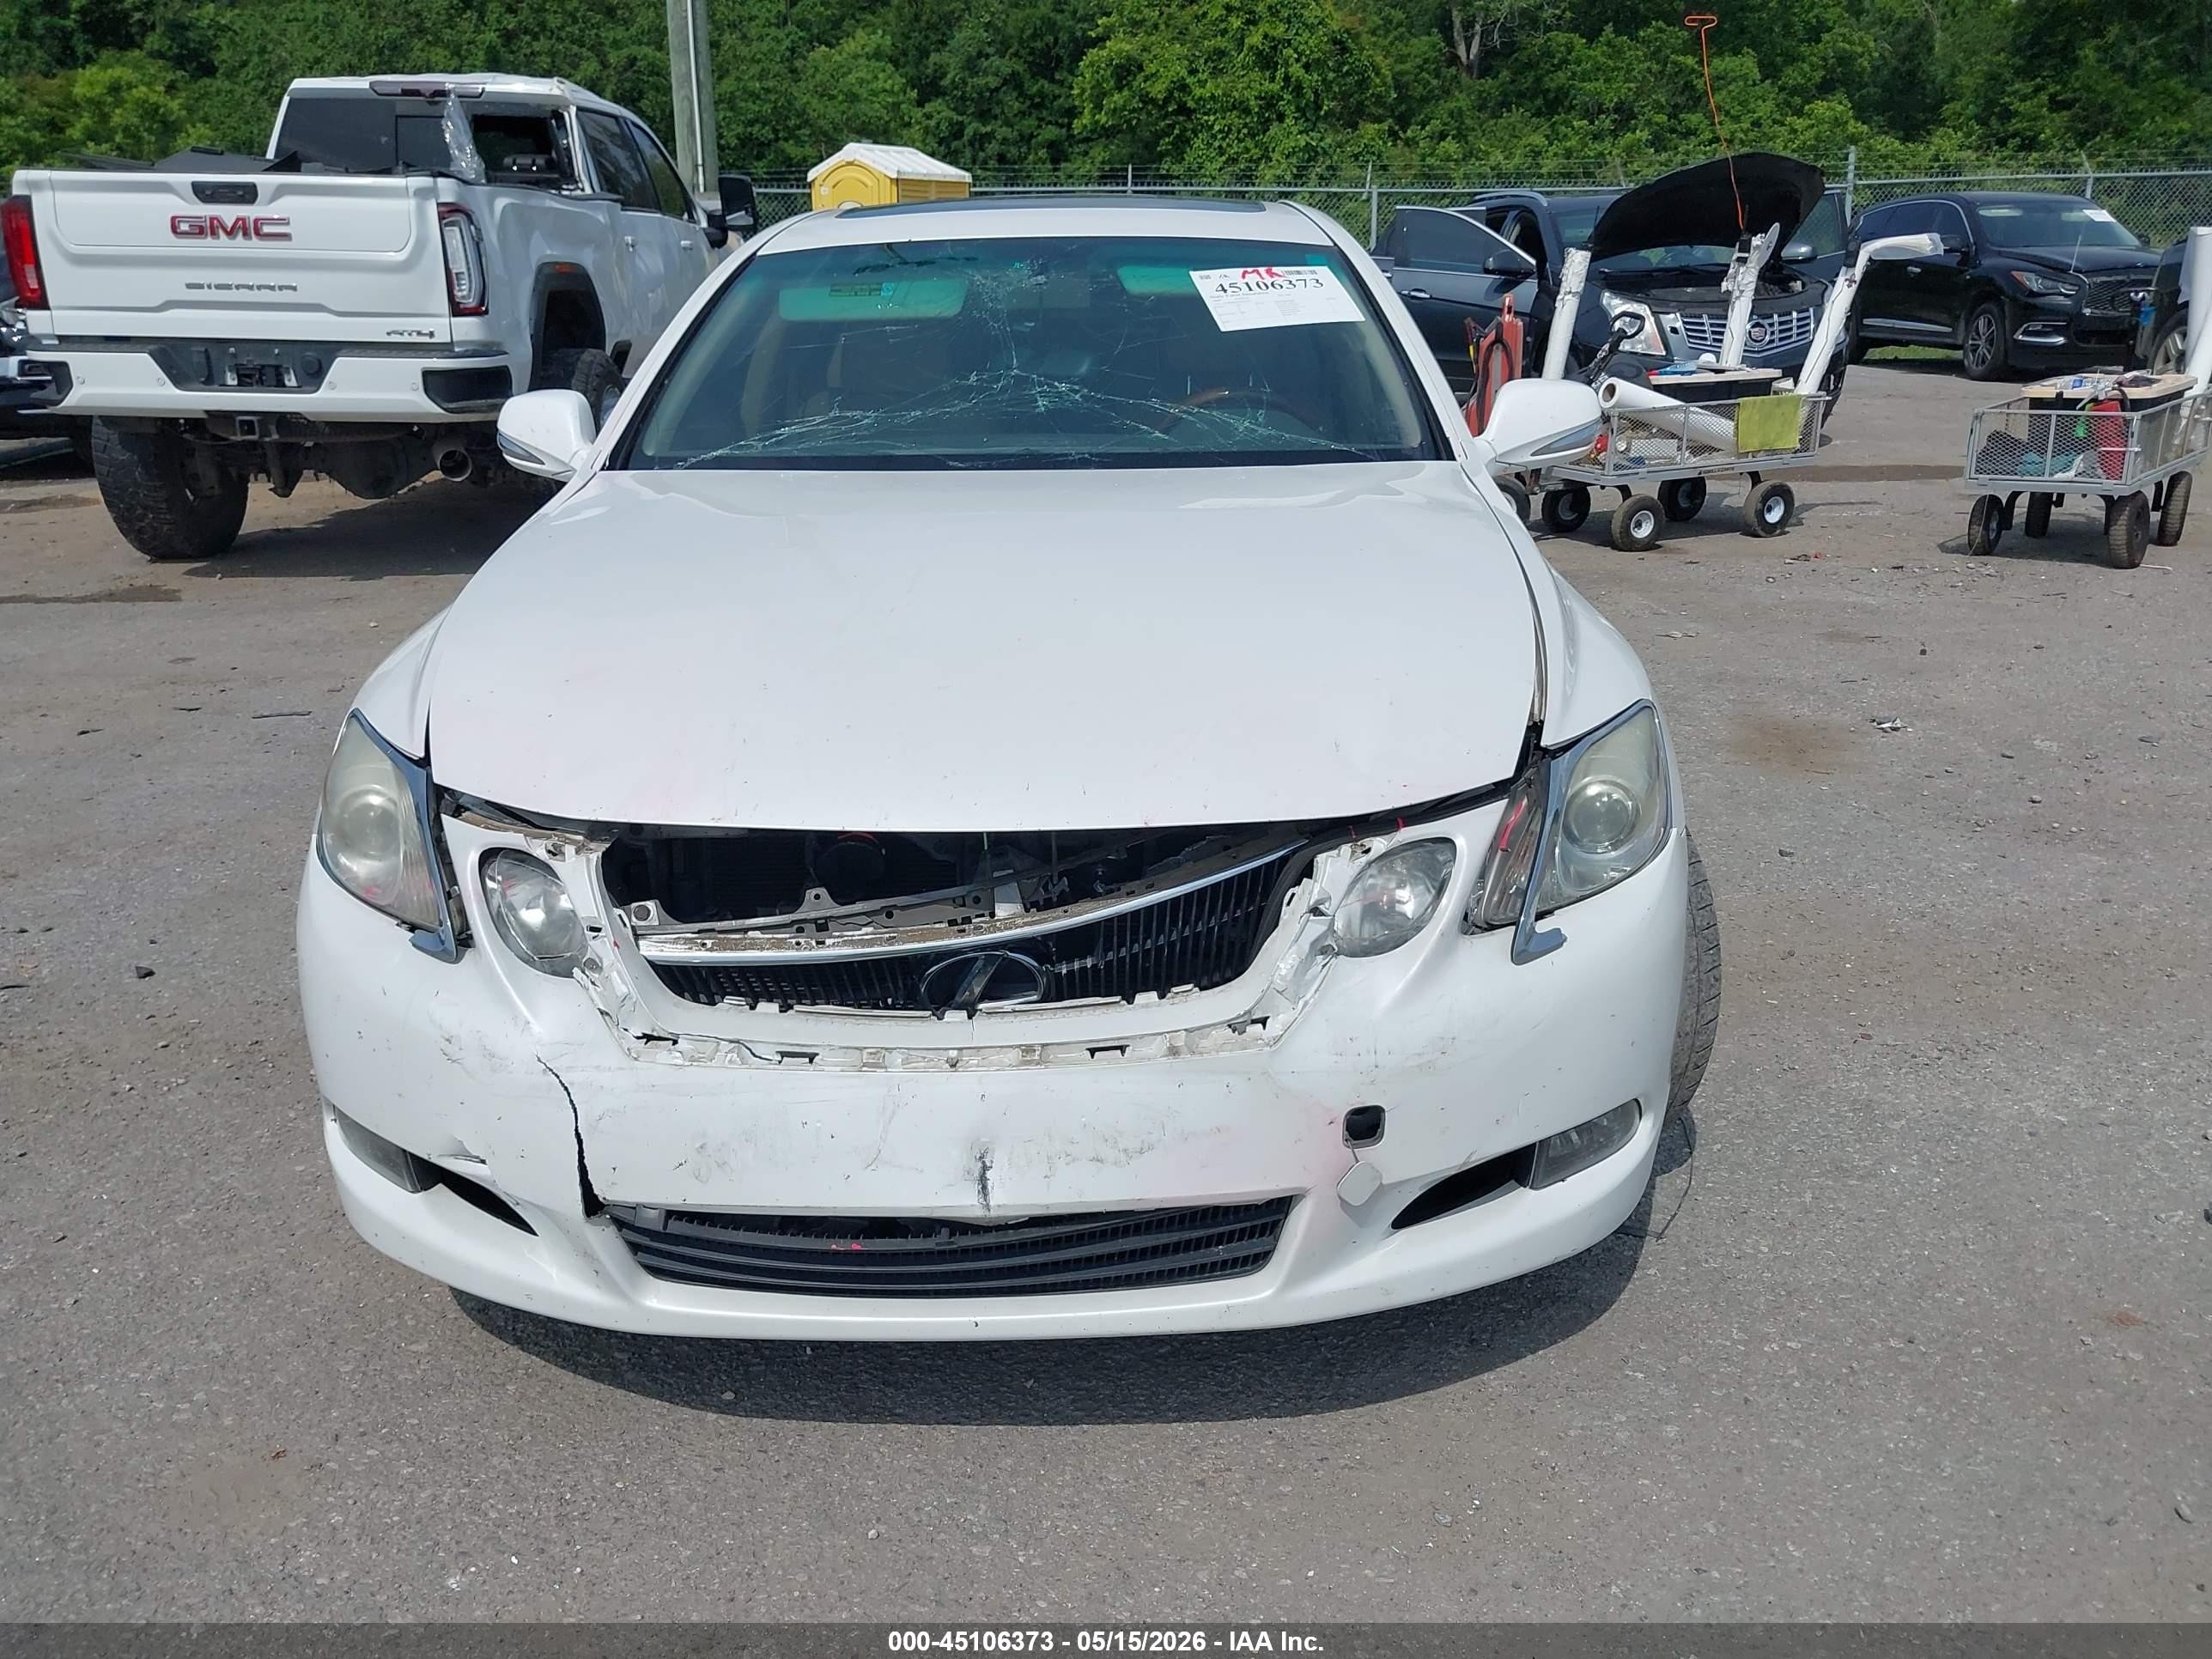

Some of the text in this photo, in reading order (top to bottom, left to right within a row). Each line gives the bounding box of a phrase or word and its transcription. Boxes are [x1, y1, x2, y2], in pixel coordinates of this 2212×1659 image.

[170, 215, 293, 242] GMC
[185, 282, 298, 292] SIERRA
[1215, 277, 1324, 294] 45106373
